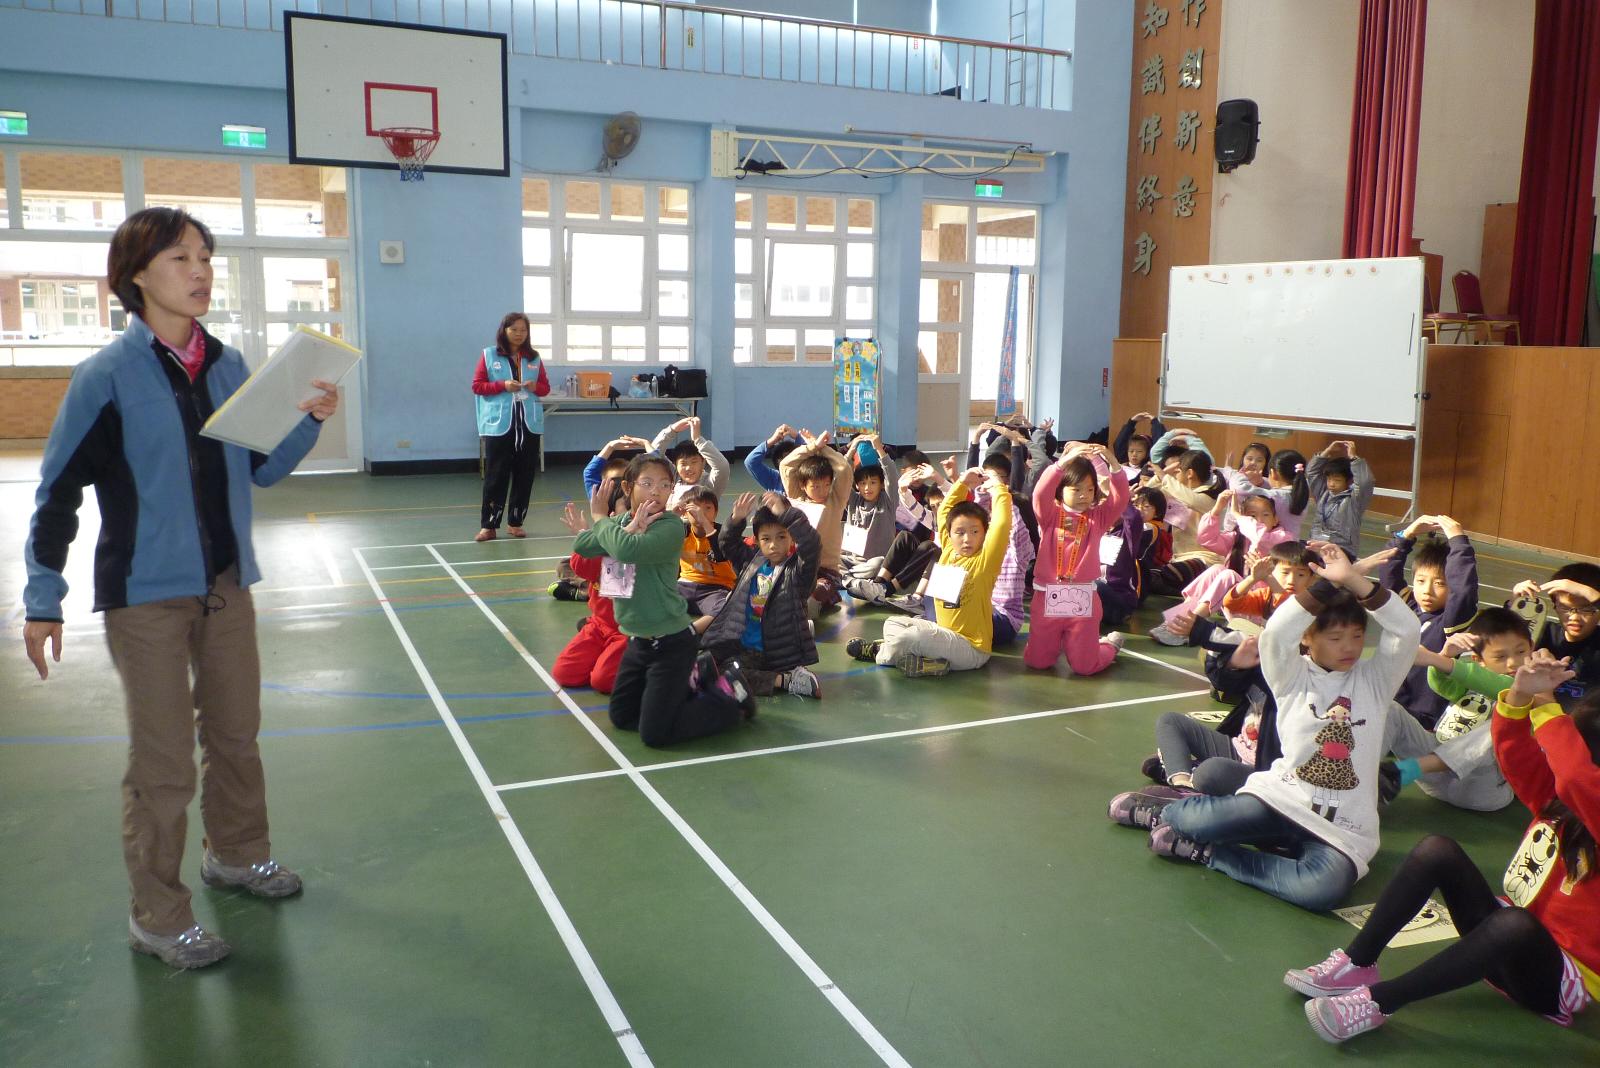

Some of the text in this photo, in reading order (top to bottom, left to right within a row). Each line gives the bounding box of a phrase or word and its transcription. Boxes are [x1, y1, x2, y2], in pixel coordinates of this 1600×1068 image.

[1131, 1, 1169, 276] 知識伴終身
